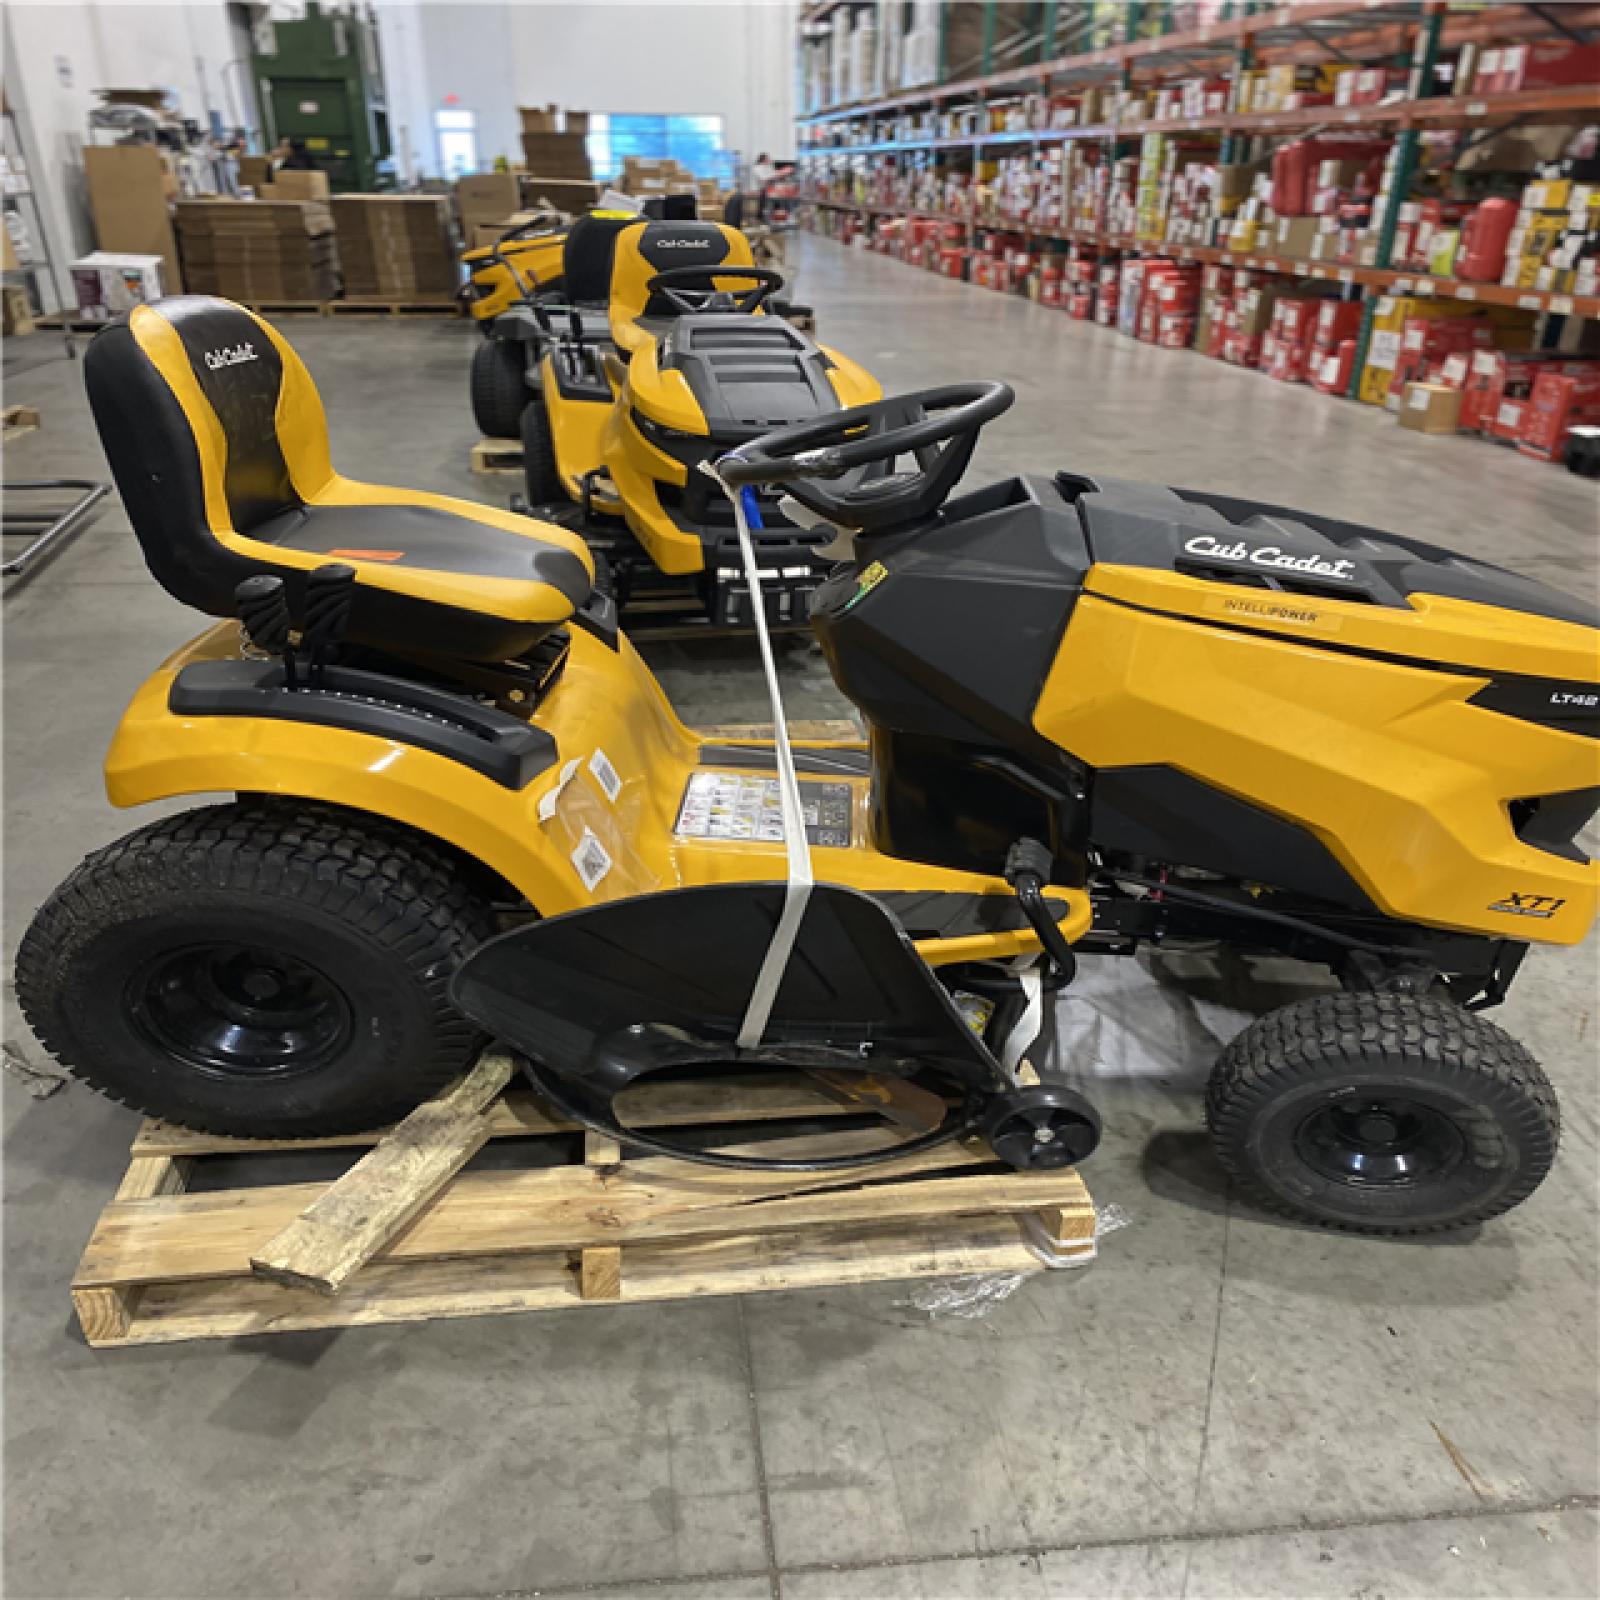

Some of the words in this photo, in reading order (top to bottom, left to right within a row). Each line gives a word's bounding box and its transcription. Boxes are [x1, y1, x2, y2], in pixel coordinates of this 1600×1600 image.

[204, 348, 223, 370] Cub
[222, 342, 258, 366] Cadet
[1184, 535, 1248, 560] Cub
[1250, 547, 1356, 579] Cadet
[1224, 599, 1318, 623] INTELLIPOWER
